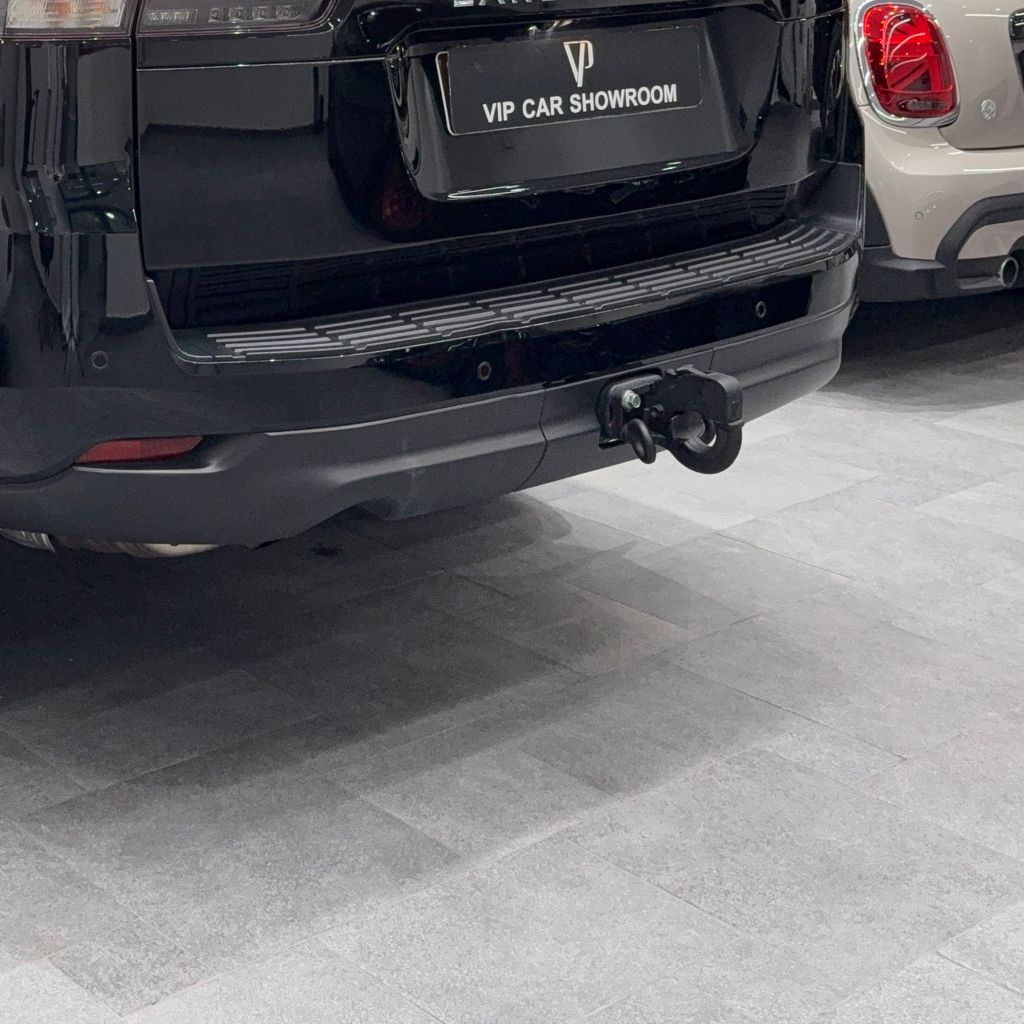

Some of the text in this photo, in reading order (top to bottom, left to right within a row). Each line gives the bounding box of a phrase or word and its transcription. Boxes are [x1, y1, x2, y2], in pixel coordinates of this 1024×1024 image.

[482, 83, 678, 124] VIP CAR SHOWROOM
